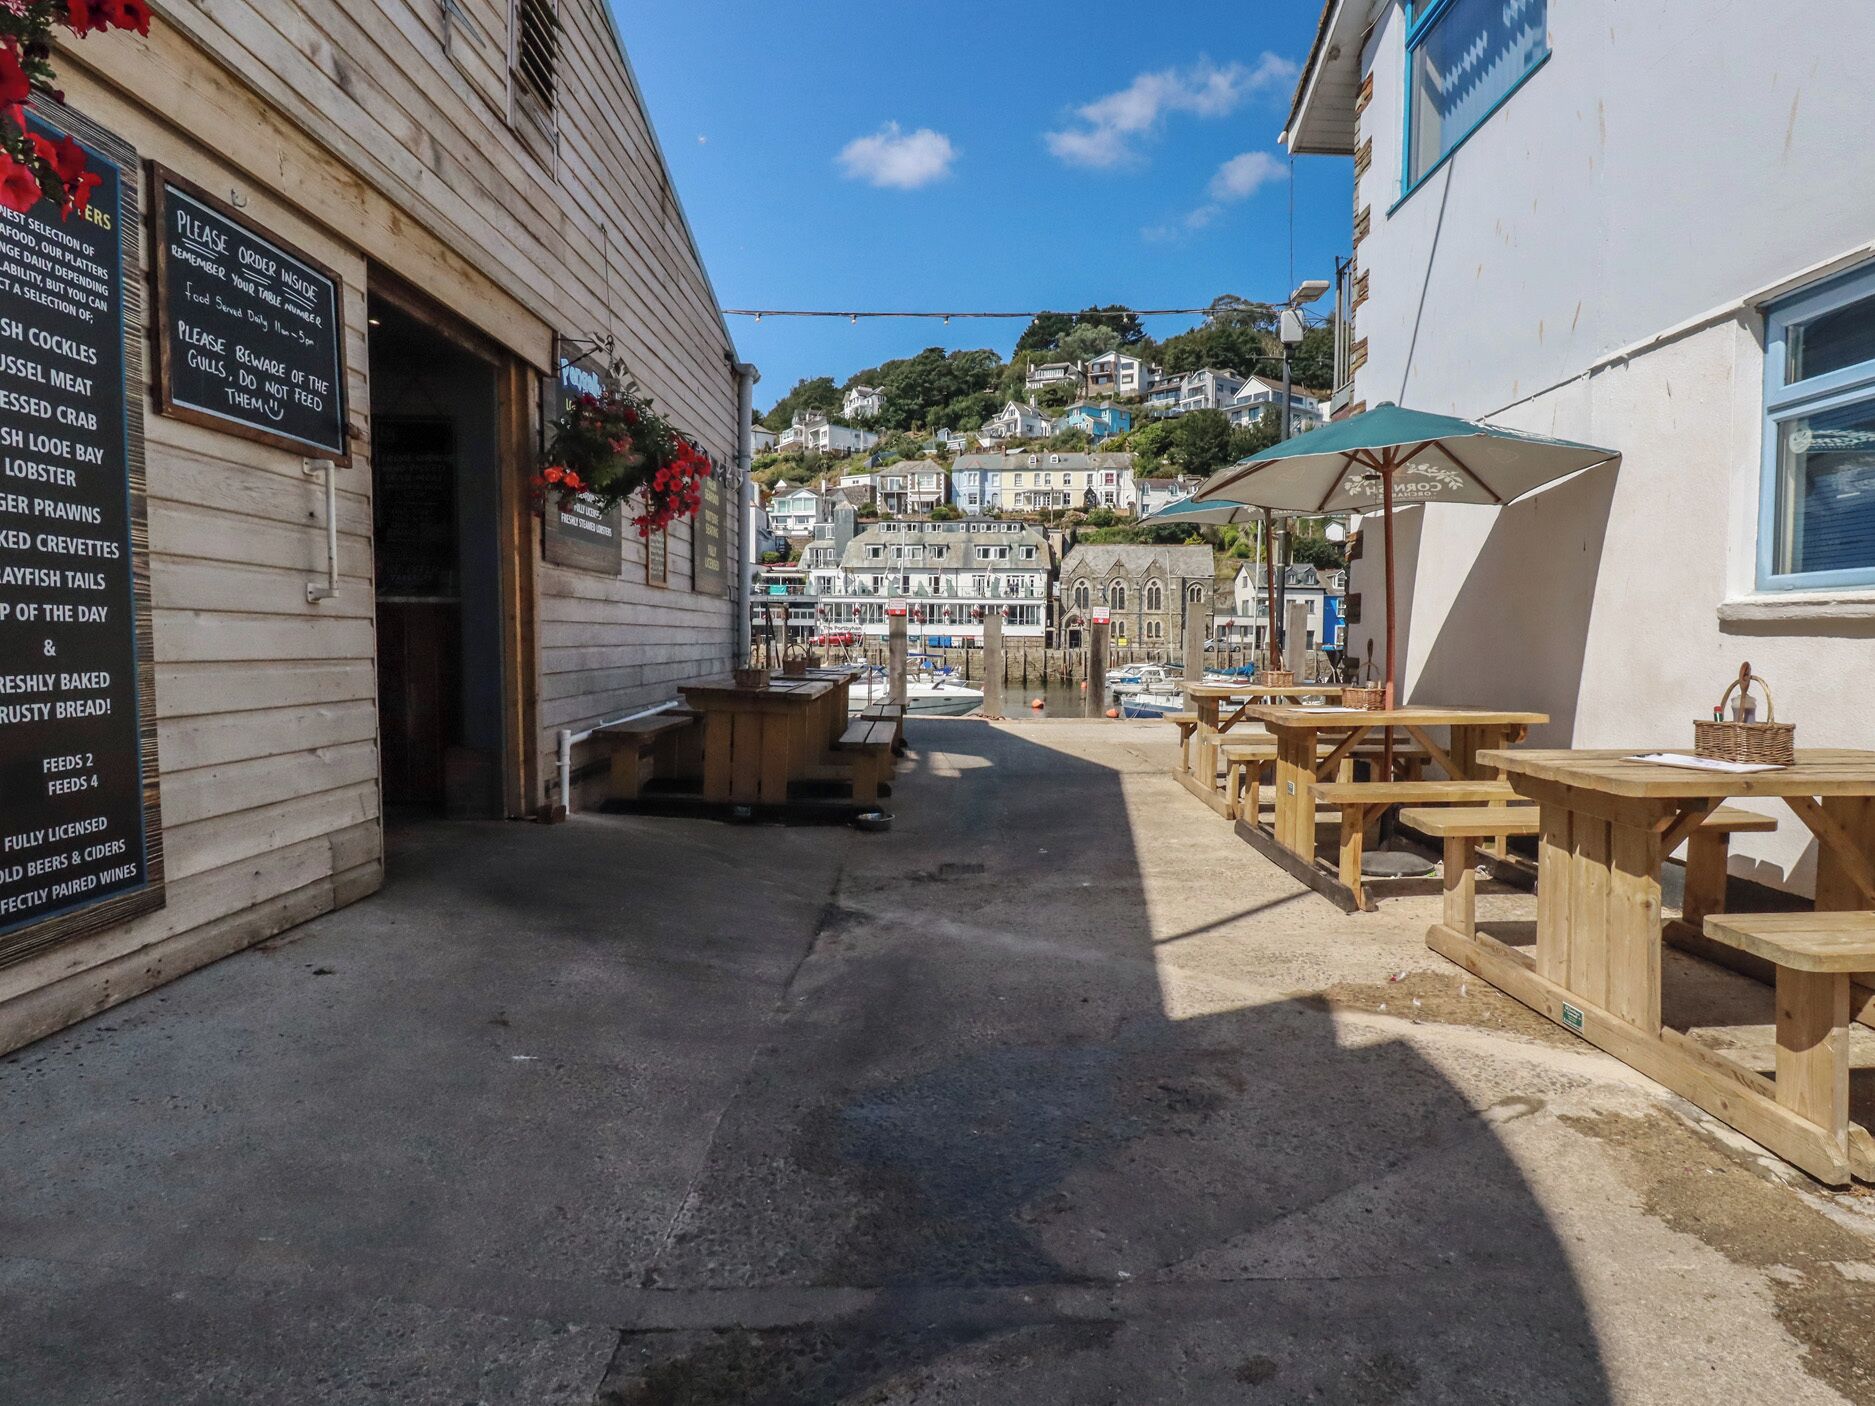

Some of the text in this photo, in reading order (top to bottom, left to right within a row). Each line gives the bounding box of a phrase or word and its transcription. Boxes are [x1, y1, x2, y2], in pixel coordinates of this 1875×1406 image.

[84, 203, 112, 231] ERS
[28, 217, 80, 251] SELECTION
[82, 243, 95, 257] OF
[41, 241, 63, 260] OUR
[64, 251, 109, 280] PLATTERS
[176, 209, 319, 303] PLEASE ORDER INSIDE
[23, 250, 53, 272] DAILY
[54, 264, 109, 297] DEPENDING
[171, 244, 323, 329] REMEMBER YOUR TABLE NUMBER
[12, 282, 22, 296] A
[23, 286, 77, 317] SELECTION
[45, 277, 65, 295] BUT
[67, 286, 87, 303] YOU
[88, 295, 108, 313] CAN
[184, 281, 210, 305] Food
[215, 295, 243, 318] Served
[247, 309, 268, 332] Daily
[28, 327, 98, 366] COCKLES
[177, 319, 329, 395] PLEASE BEWARE OF THE
[50, 368, 93, 397] MEAT
[239, 369, 257, 390] DO
[265, 381, 290, 401] NOT
[294, 387, 323, 412] FEED
[224, 388, 264, 413] THEM
[56, 405, 97, 431] CRAB
[29, 432, 71, 459] LOOE
[75, 443, 104, 465] BAY
[5, 457, 77, 488] LOBSTER
[34, 497, 102, 525] PRAWNS
[36, 533, 120, 559] CREVETTES
[0, 566, 106, 590] AYFISH TAILS
[15, 602, 39, 621] OF
[42, 604, 74, 622] THE
[77, 605, 108, 623] DAY
[43, 639, 57, 657] &
[60, 671, 111, 691] BAKED
[56, 698, 111, 719] BREAD!
[43, 752, 94, 774] FEEDS 2
[48, 773, 99, 796] FEEDS 4
[4, 816, 108, 852] FULLY LICENSED
[27, 853, 68, 877] BEERS
[71, 850, 82, 865] &
[84, 838, 126, 862] CIDERS
[51, 874, 97, 900] PAIRED
[99, 862, 137, 886] WINES
